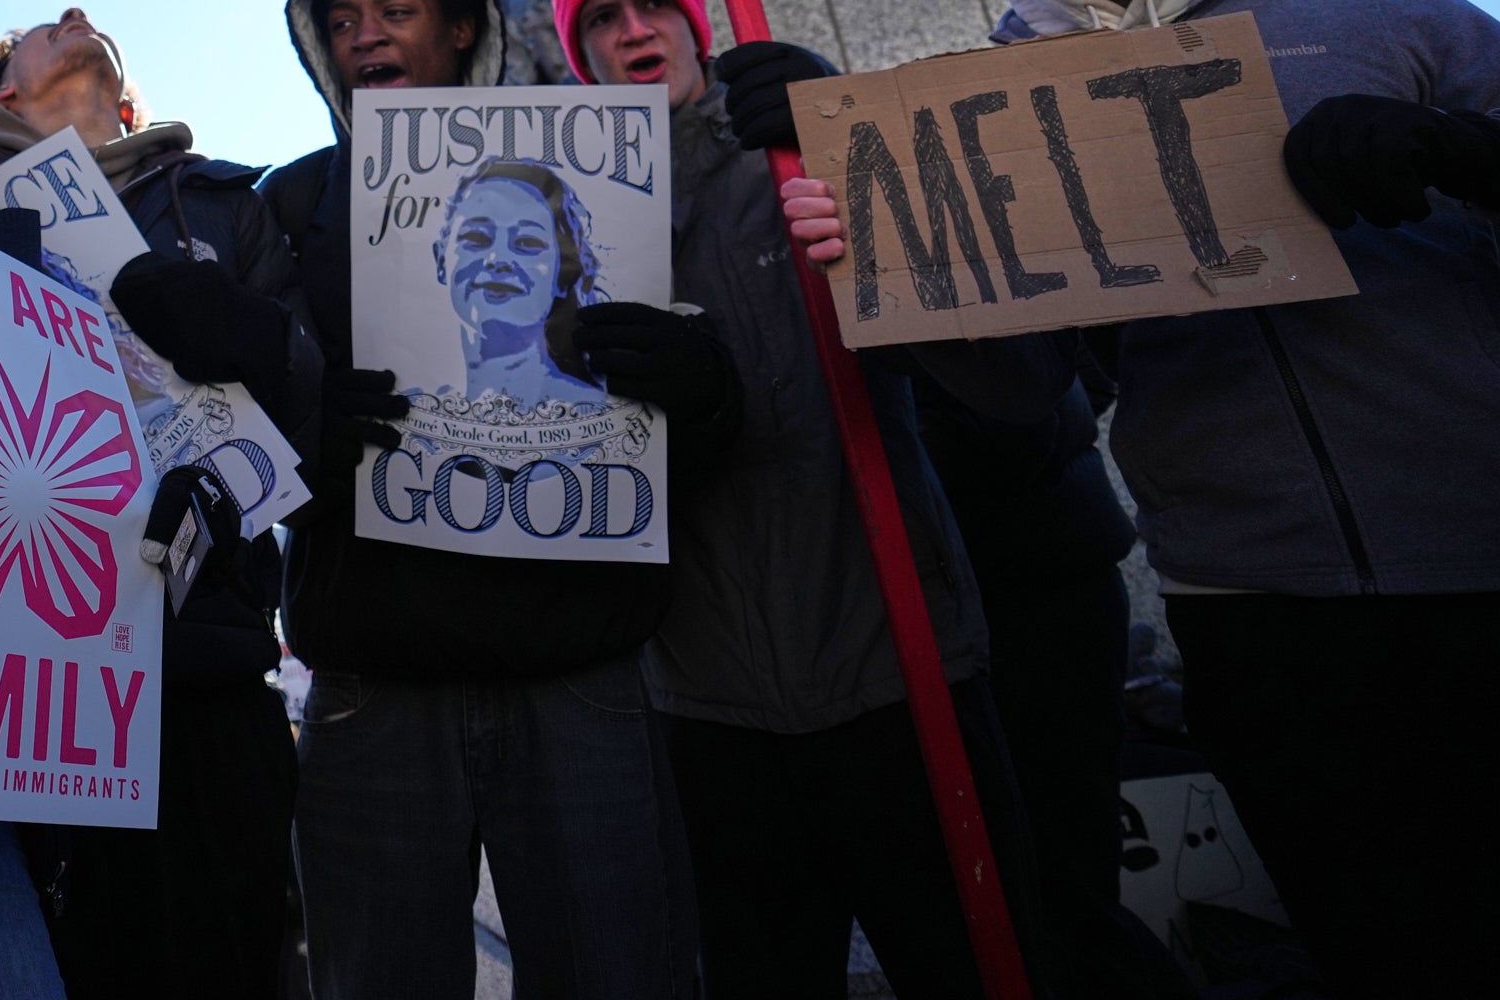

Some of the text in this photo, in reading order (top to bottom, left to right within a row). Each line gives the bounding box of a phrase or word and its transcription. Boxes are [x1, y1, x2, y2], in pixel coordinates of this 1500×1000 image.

[363, 104, 654, 198] JUSTICE
[368, 173, 441, 247] for
[845, 56, 1242, 322] MELT
[8, 270, 117, 376] ARE
[402, 417, 438, 434] eneé
[443, 424, 485, 443] Nicole
[487, 429, 533, 447] Good,
[370, 446, 655, 541] GOOD
[114, 641, 130, 651] RISE
[115, 625, 130, 635] LOVE
[115, 633, 130, 643] HOPE
[3, 767, 141, 802] IMMIGRANTS
